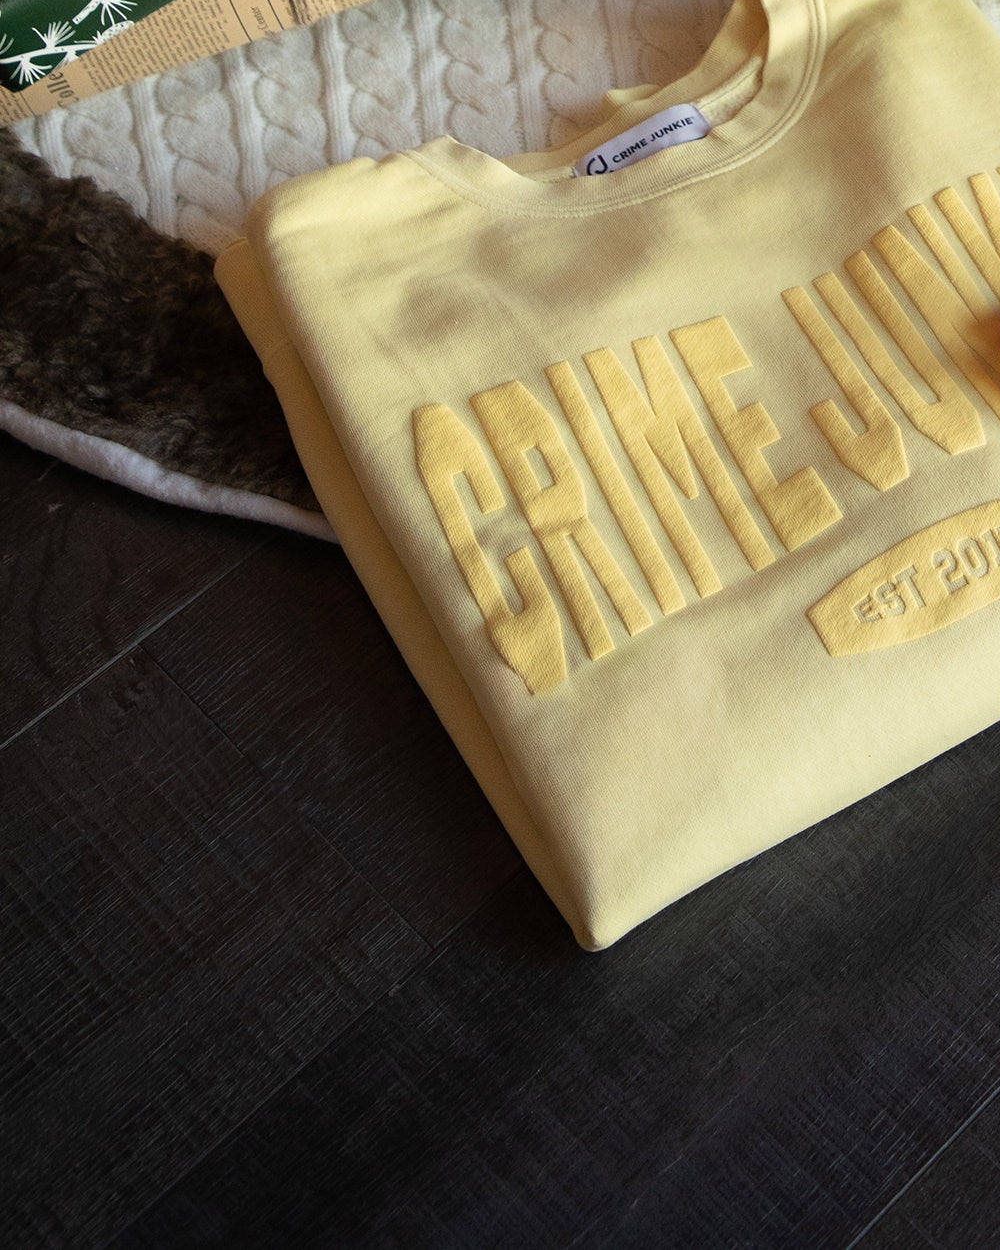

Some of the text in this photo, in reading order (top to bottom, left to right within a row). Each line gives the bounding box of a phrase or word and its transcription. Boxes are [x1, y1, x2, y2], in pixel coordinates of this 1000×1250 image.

[612, 138, 648, 163] CRIME
[411, 315, 843, 695] CRIME
[851, 569, 923, 626] EST
